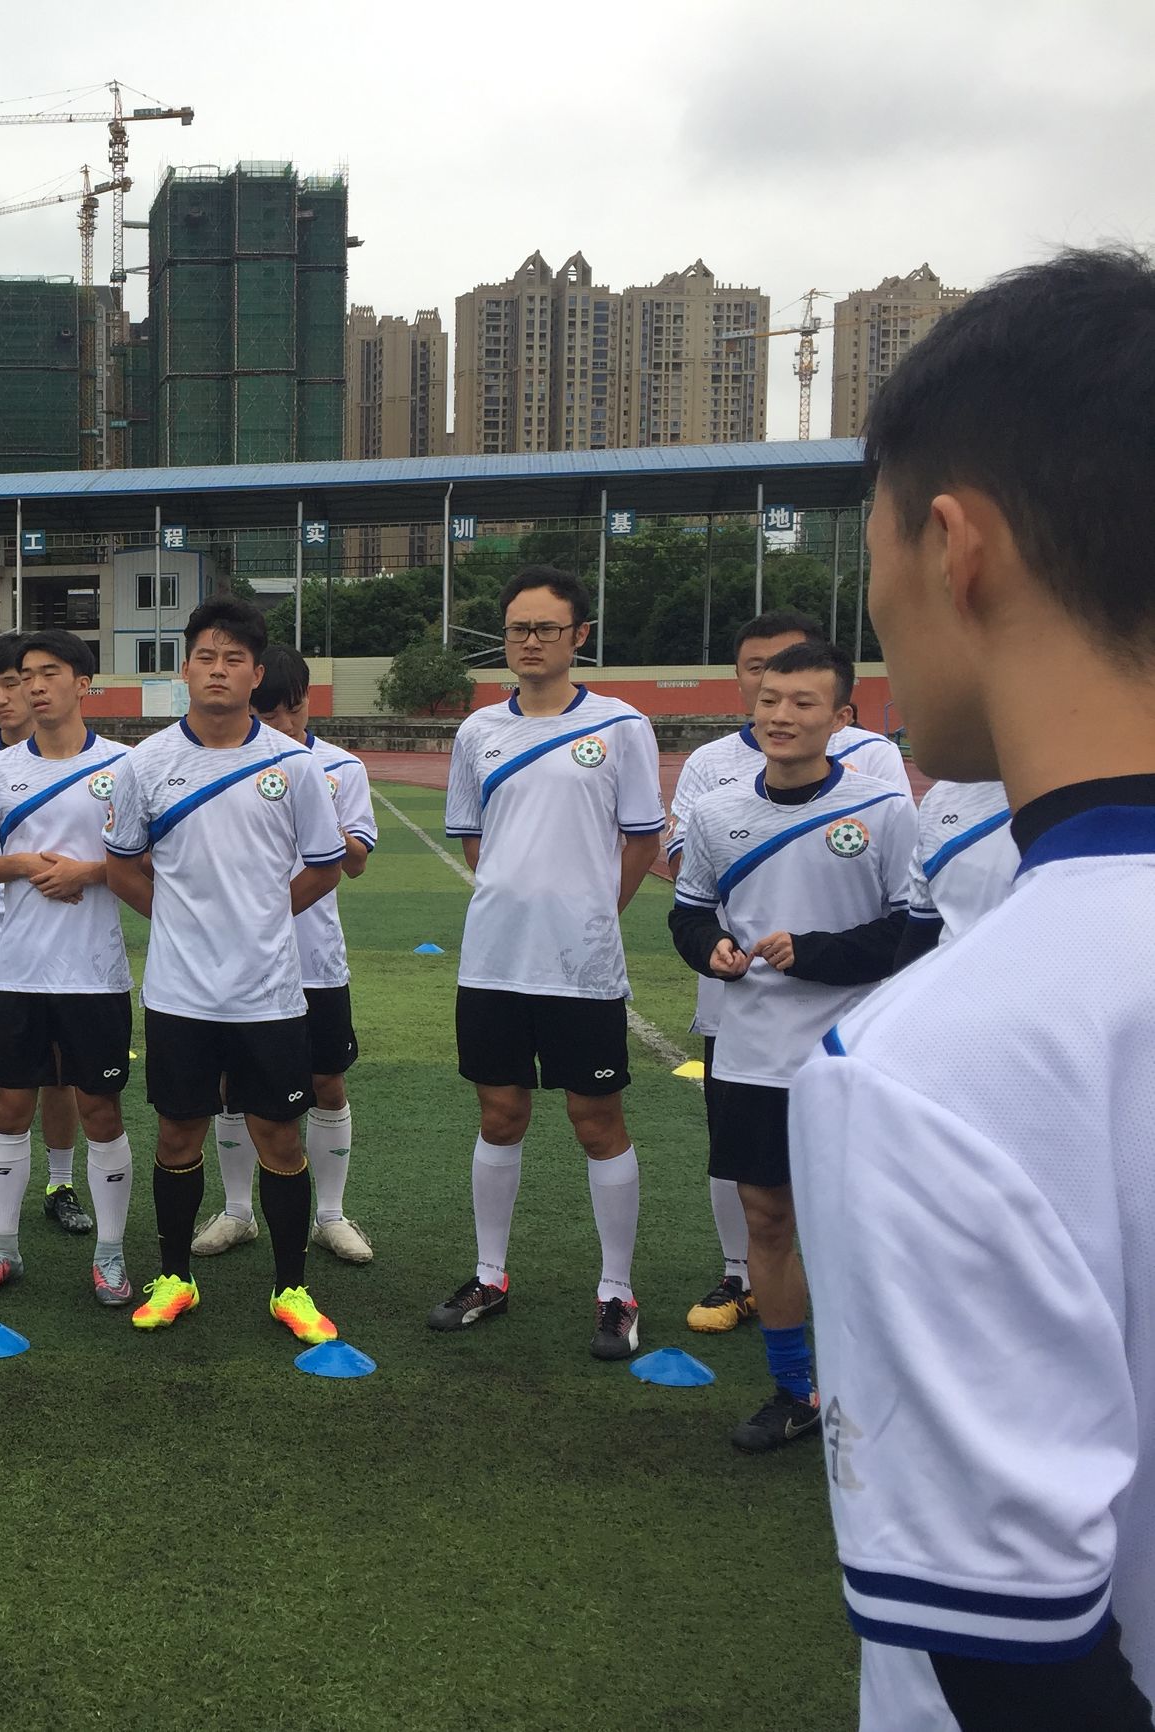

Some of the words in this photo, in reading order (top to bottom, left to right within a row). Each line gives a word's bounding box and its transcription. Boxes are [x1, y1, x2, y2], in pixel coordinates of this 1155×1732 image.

[23, 532, 44, 551] 工
[163, 527, 185, 549] 程
[305, 522, 326, 543] 实
[452, 518, 474, 539] 训
[610, 511, 633, 534] 基
[768, 507, 791, 528] 地
